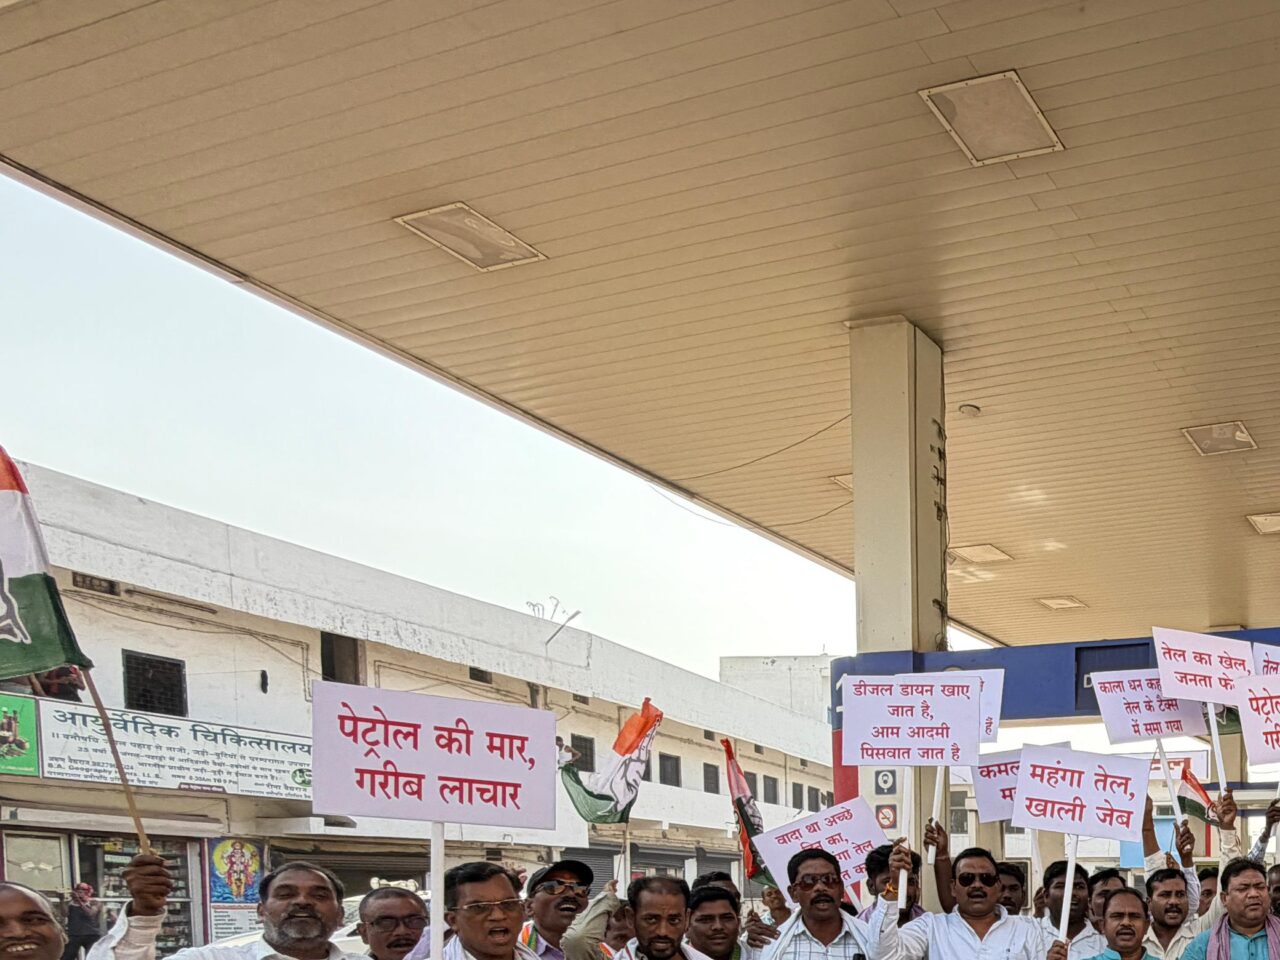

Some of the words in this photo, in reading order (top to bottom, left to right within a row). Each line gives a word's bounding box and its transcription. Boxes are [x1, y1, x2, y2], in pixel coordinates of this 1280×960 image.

[1161, 642, 1186, 663] तेल
[1192, 652, 1212, 666] का
[1218, 651, 1251, 676] खेल,
[853, 680, 894, 696] डीजल
[900, 684, 934, 696] डायन
[941, 684, 970, 699] खाए
[1098, 680, 1124, 694] काला
[1128, 679, 1143, 692] धन
[1174, 672, 1212, 689] जनता
[888, 704, 915, 717] जात
[921, 700, 934, 720] है,
[1124, 697, 1141, 714] तेल
[1144, 695, 1155, 712] के
[1157, 694, 1179, 712] टैक्स
[53, 710, 181, 738] आयुर्वेदिक
[190, 724, 312, 755] चिकित्सालय
[338, 702, 421, 758] पेट्रोल
[434, 718, 473, 756] की
[486, 732, 535, 770] मार,
[872, 726, 900, 738] आम
[907, 722, 950, 740] आदमी
[1132, 718, 1140, 736] में
[1144, 722, 1163, 736] समा
[860, 742, 911, 760] पिसवात
[918, 748, 944, 760] जात
[951, 743, 960, 761] है
[354, 760, 426, 800] गरीब
[438, 776, 521, 810] लाचार
[1030, 760, 1084, 788] महंगा
[1094, 764, 1134, 801] तेल,
[1025, 796, 1086, 822] खाली
[1096, 799, 1134, 830] जेब
[775, 829, 802, 845] वादा
[806, 822, 821, 834] था
[825, 807, 853, 827] अच्छे
[826, 833, 848, 846] का,
[852, 840, 874, 855] तेल
